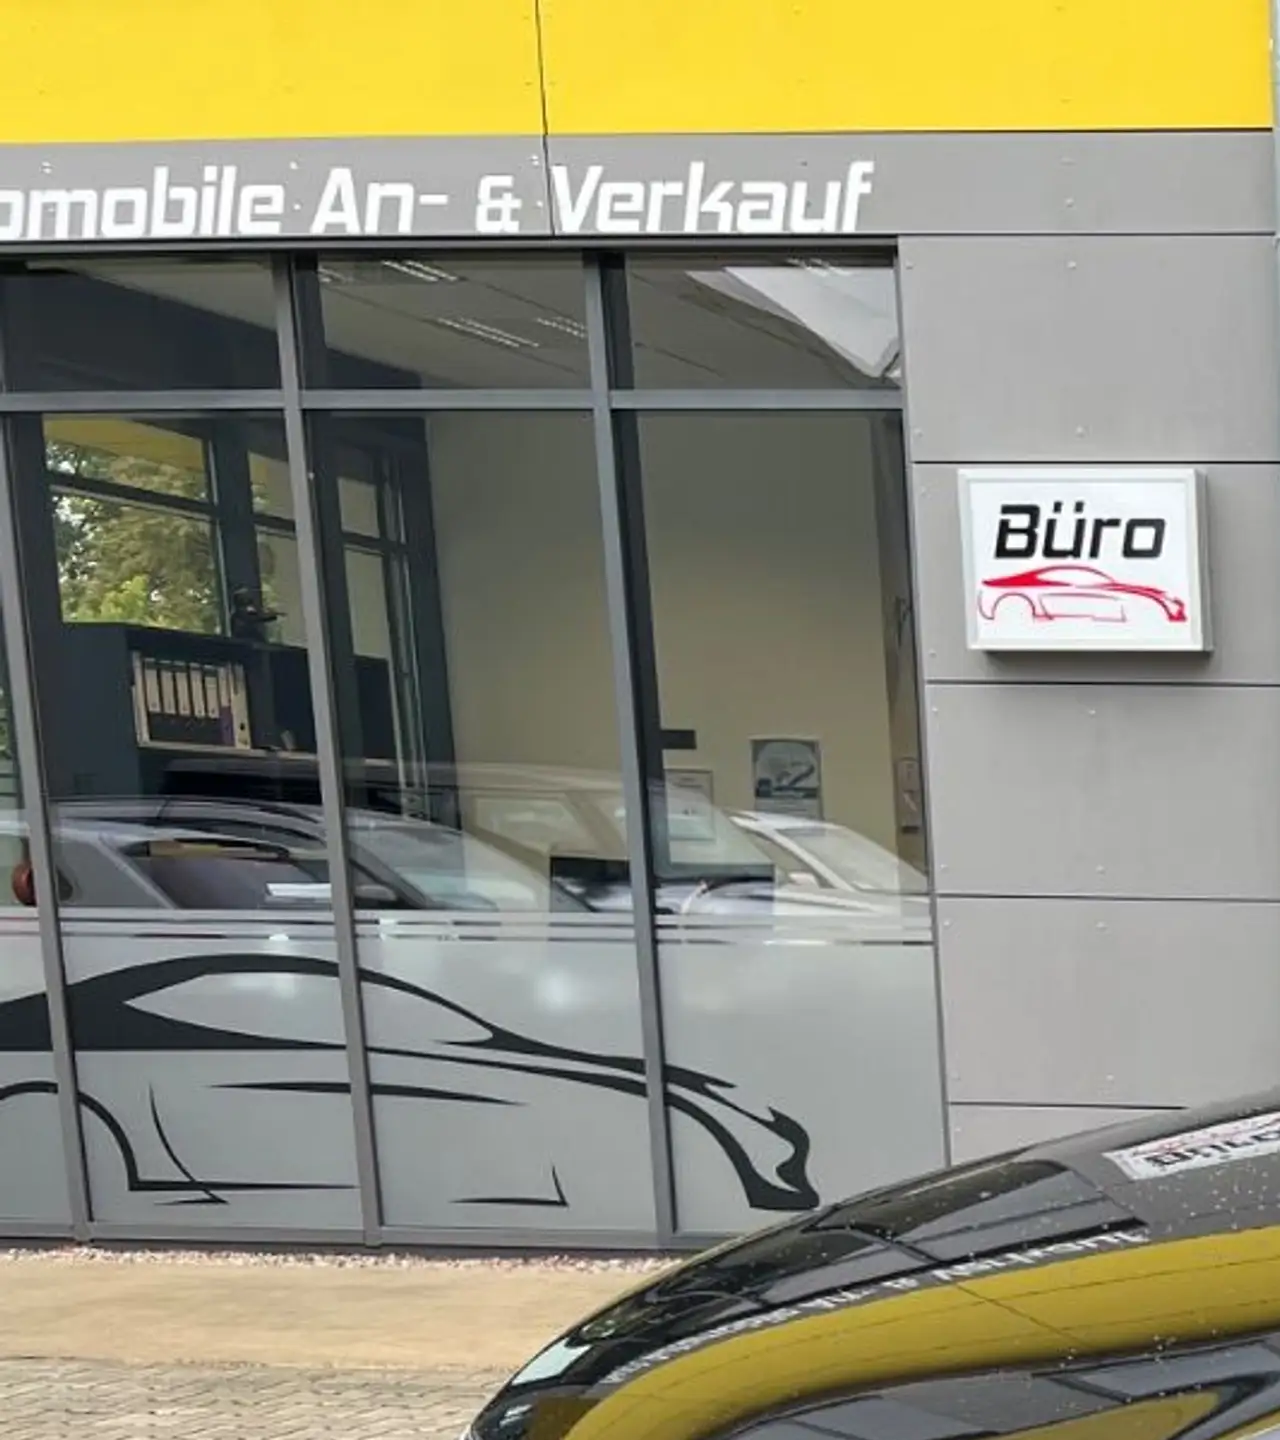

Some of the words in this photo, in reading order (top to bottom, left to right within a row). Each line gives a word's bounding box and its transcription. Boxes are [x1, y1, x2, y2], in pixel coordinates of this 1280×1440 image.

[311, 167, 449, 235] An-
[476, 174, 522, 234] &
[552, 161, 875, 234] Verkauf
[994, 501, 1166, 560] Büro
